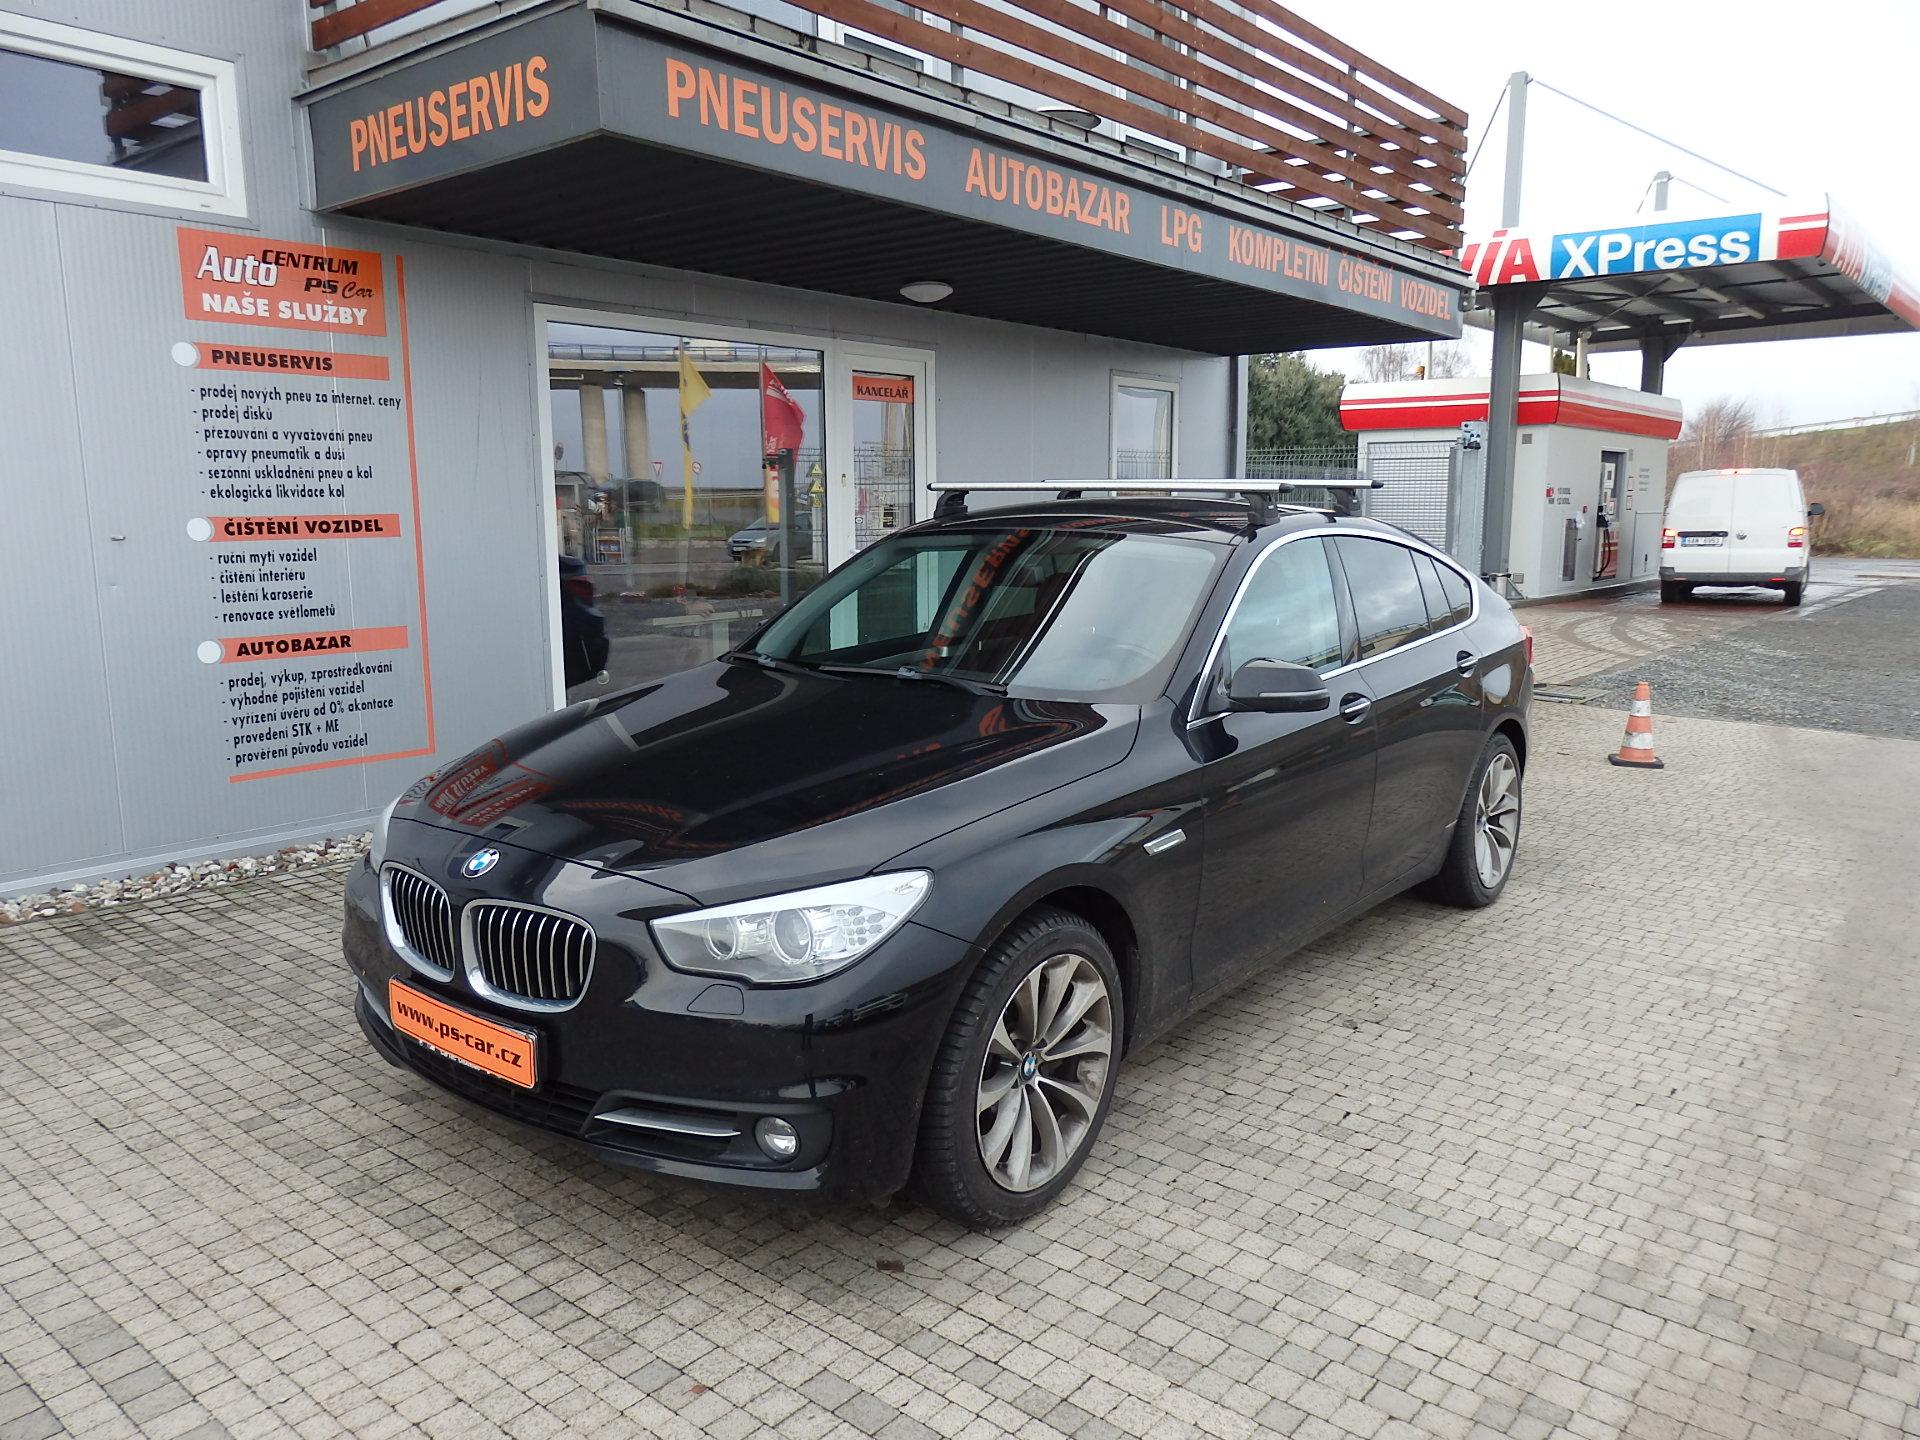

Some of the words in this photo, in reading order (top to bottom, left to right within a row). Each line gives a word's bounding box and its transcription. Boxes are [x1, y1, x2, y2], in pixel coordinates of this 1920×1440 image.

[349, 55, 551, 172] PNEUSERVIS
[665, 57, 927, 181] PNEUSERVIS
[964, 148, 1131, 235] AUTOBAZAR
[1161, 205, 1203, 254] LPG
[1228, 224, 1330, 287] KOMPLETNÍ
[1338, 252, 1394, 304] ČIŠTĚNÍ
[1400, 276, 1451, 321] VOZIDEL
[196, 245, 279, 288] Auto
[261, 249, 359, 276] CENTRUM
[1559, 231, 1752, 280] XPress
[304, 277, 339, 295] PS
[341, 281, 375, 299] Car
[202, 291, 270, 317] NAŠE
[278, 300, 368, 326] SLUŽBY
[211, 349, 333, 371] PNEUSERVIS
[200, 384, 238, 403] prodej
[241, 386, 282, 403] nových
[285, 391, 311, 404] pneu
[315, 393, 328, 403] za
[331, 389, 375, 406] internet.
[378, 396, 401, 410] ceny
[856, 384, 909, 399] KANCELÁŘ
[202, 404, 240, 423] prodej
[204, 427, 268, 442] přezouvání
[272, 431, 279, 440] a
[283, 429, 345, 444] vyvažování
[348, 432, 373, 445] pneu
[206, 449, 247, 463] opravy
[251, 446, 310, 463] pneumatik
[314, 451, 321, 459] a
[208, 466, 251, 479] sezónní
[255, 465, 314, 479] uskladnění
[318, 469, 343, 482] pneu
[347, 470, 353, 479] a
[356, 465, 373, 479] kol
[210, 484, 272, 501] ekologická
[276, 484, 325, 498] likvidace
[328, 483, 345, 498] kol
[224, 517, 299, 536] ČIŠTĚNÍ
[304, 519, 384, 534] VOZIDEL
[218, 551, 246, 564] ruční
[279, 547, 317, 562] vozidel
[220, 569, 256, 583] čištění
[259, 567, 306, 582] interiéru
[221, 589, 259, 603] leštění
[262, 586, 313, 601] karoserie
[223, 610, 274, 623] renovace
[278, 604, 336, 619] světlometů
[236, 634, 352, 657] AUTOBAZAR
[228, 672, 267, 692] prodej,
[271, 668, 307, 687] výkup,
[311, 661, 393, 683] zprostředkování
[230, 690, 278, 710] výhodné
[282, 685, 325, 705] pojištění
[329, 680, 365, 696] vozidel
[232, 709, 277, 729] vyřízení
[280, 707, 310, 721] úvěru
[313, 702, 326, 716] od
[329, 700, 345, 714] 0%
[348, 698, 394, 712] akontace
[233, 727, 289, 749] provedení
[292, 722, 312, 738] STK
[325, 719, 340, 734] ME
[235, 745, 288, 767] prověření
[291, 738, 329, 759] původu
[332, 732, 368, 750] vozidel
[396, 1000, 522, 1069] www.ps-car.cz
